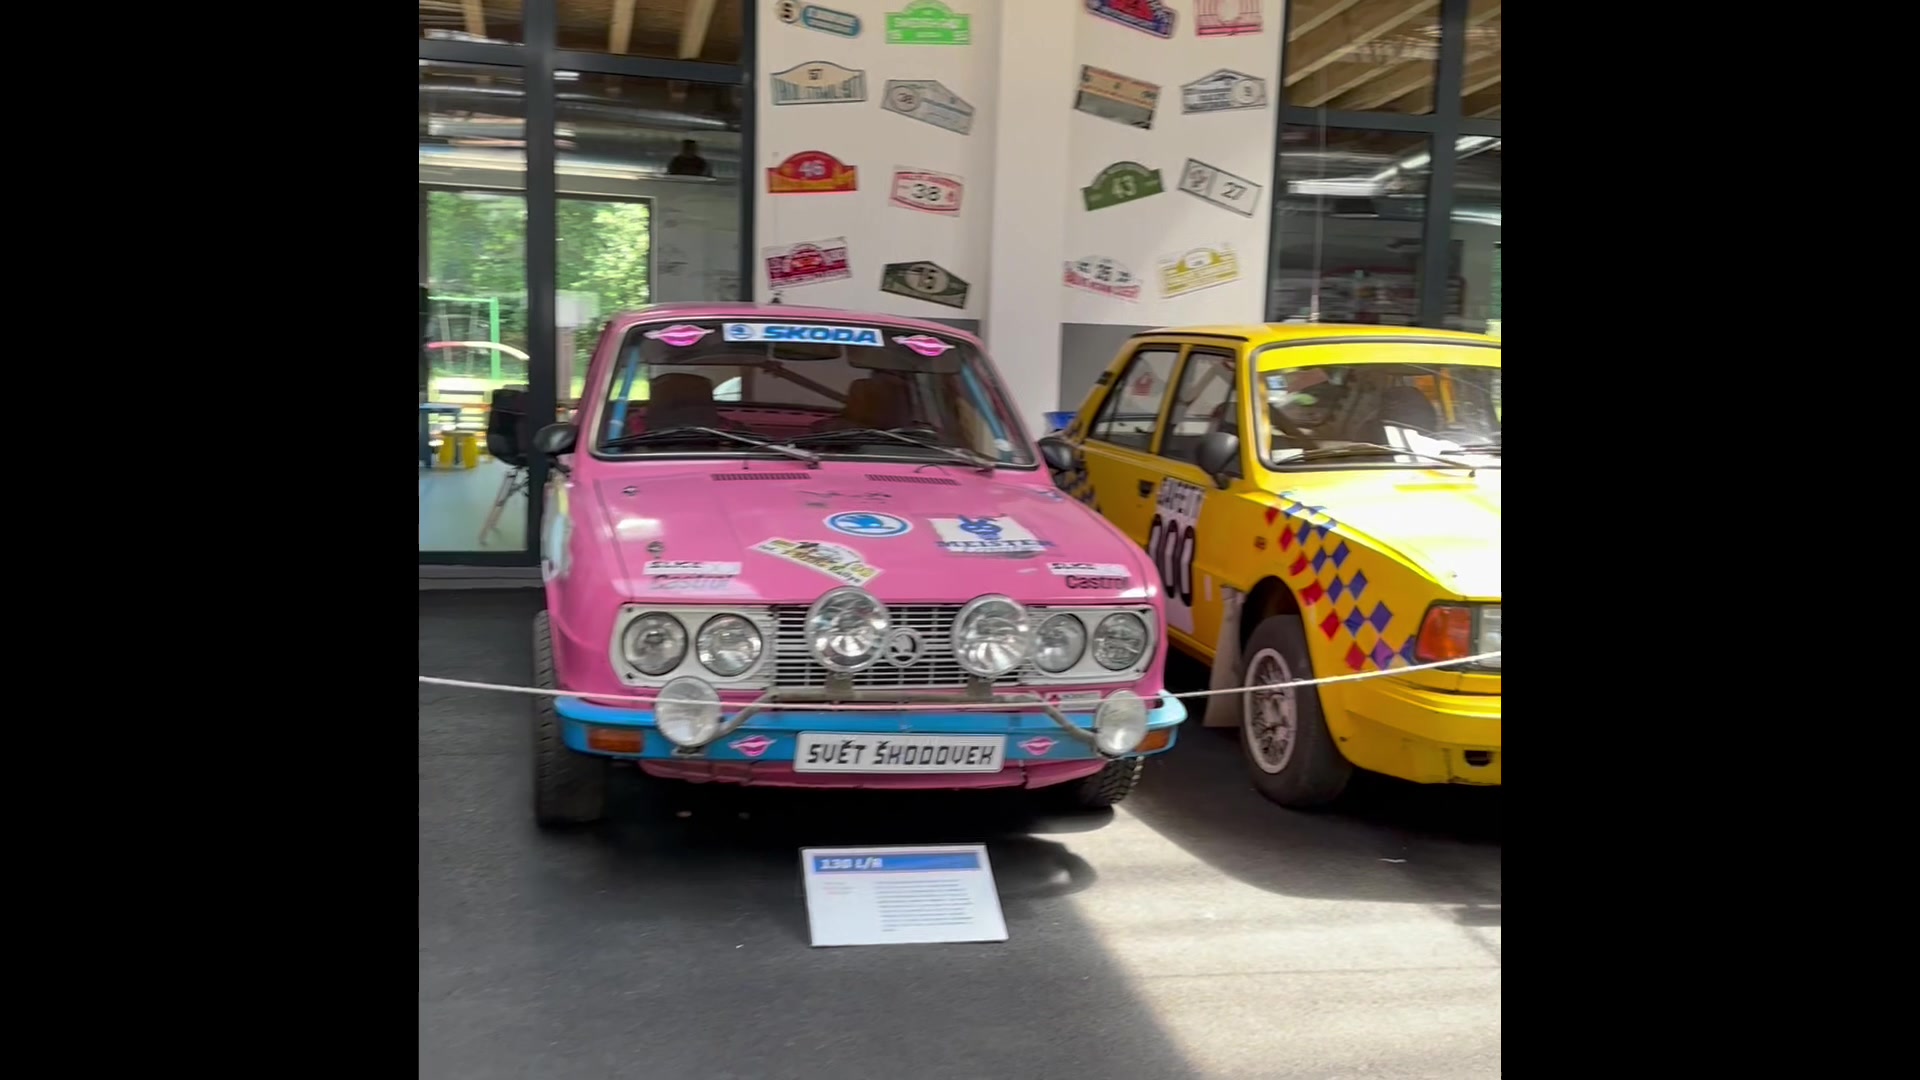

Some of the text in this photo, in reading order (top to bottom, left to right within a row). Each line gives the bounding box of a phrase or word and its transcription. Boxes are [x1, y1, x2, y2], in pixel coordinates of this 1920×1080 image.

[911, 183, 941, 201] 38
[1111, 175, 1136, 199] 43
[1221, 182, 1247, 200] 27
[1065, 575, 1130, 590] Castrol
[807, 740, 996, 765] SVĚT ŠKODOVEK
